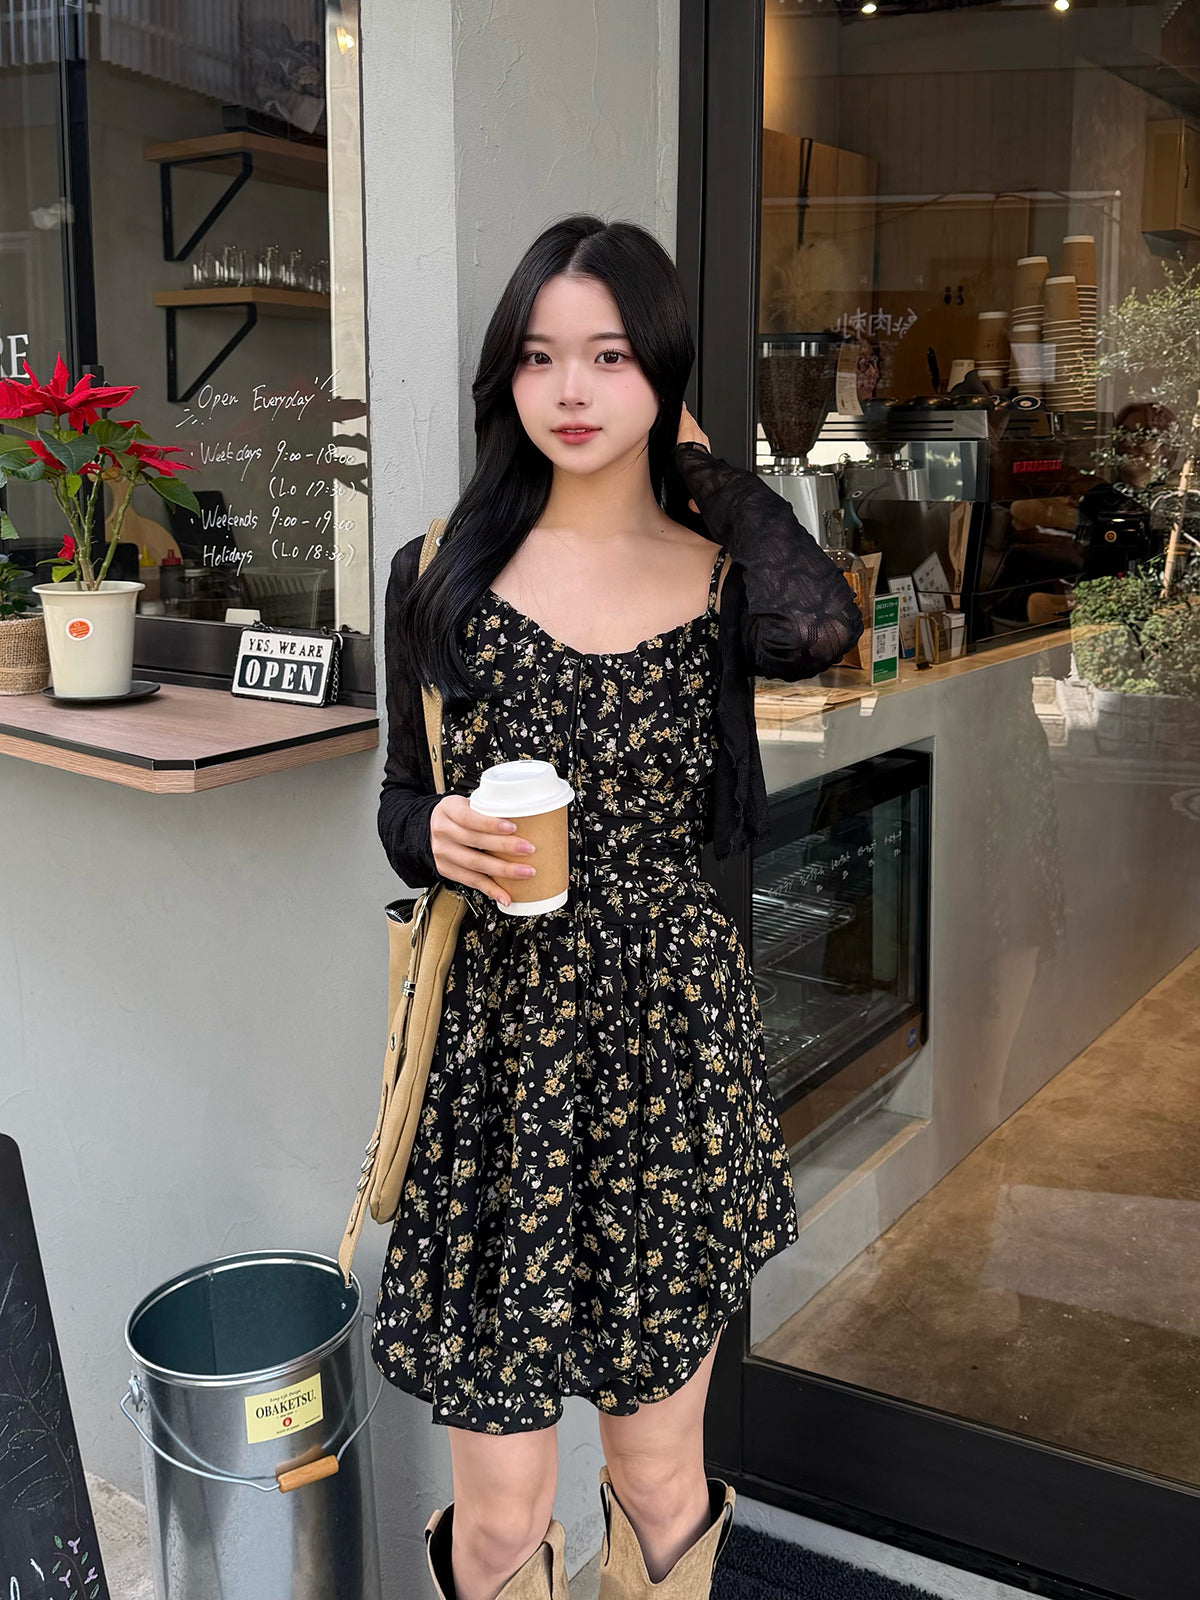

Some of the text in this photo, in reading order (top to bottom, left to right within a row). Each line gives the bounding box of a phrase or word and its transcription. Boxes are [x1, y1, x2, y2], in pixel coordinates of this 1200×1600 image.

[0, 334, 31, 379] E
[198, 384, 316, 421] Open Everyday
[200, 442, 262, 481] Weekdays
[201, 504, 259, 531] Weekends
[203, 544, 253, 577] Holidays
[249, 638, 324, 658] YES, WE ARE
[245, 658, 317, 692] OPEN
